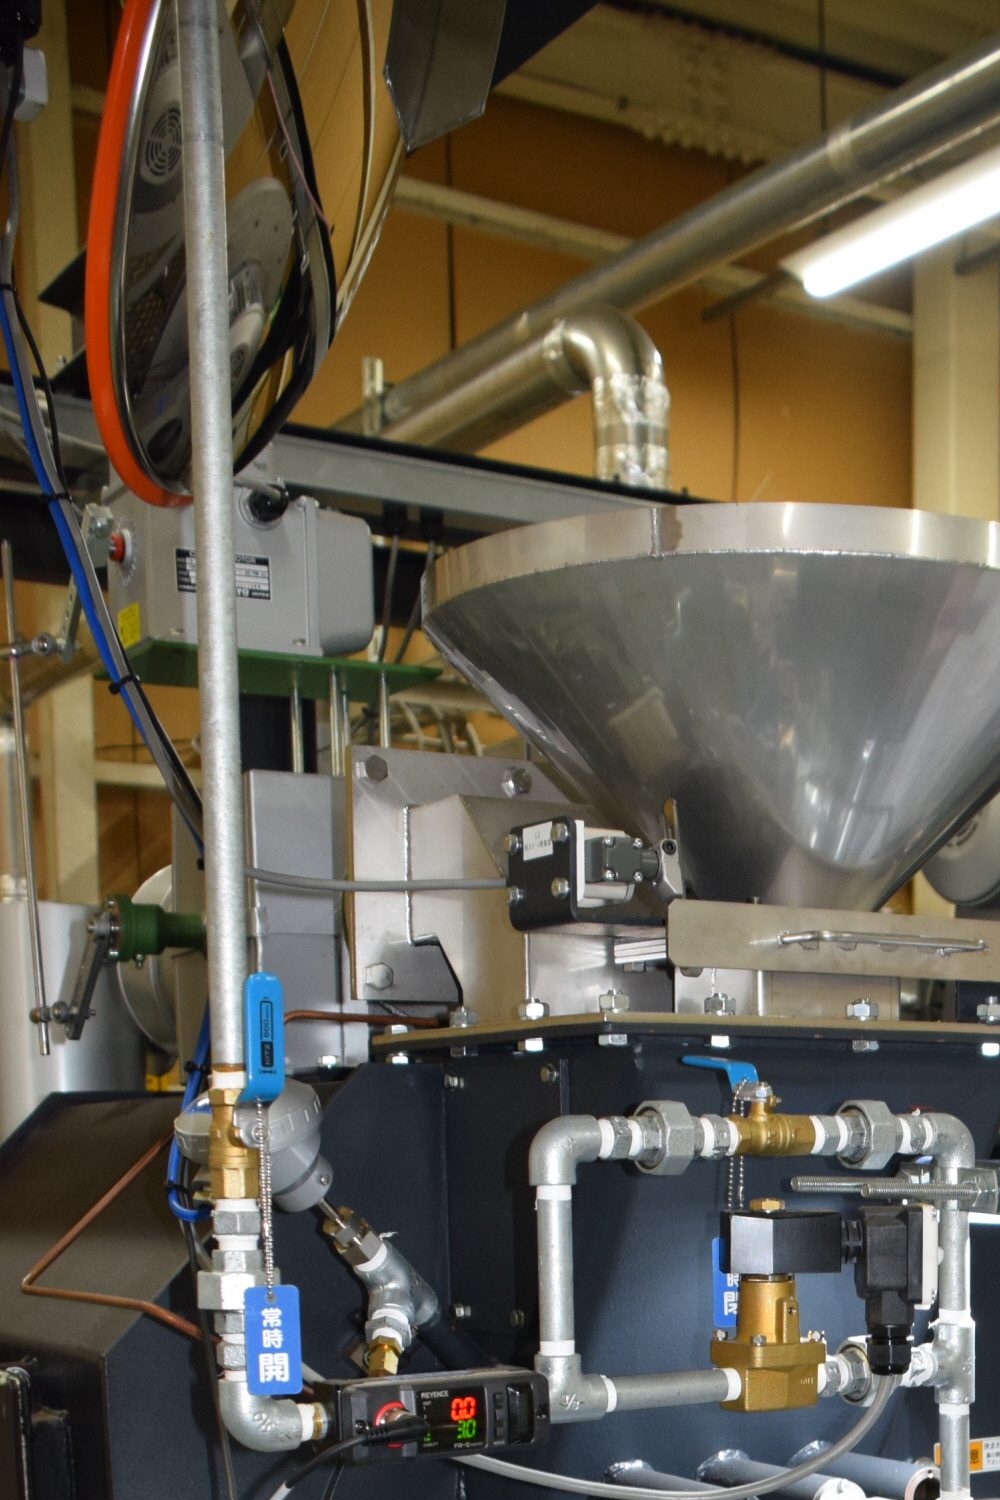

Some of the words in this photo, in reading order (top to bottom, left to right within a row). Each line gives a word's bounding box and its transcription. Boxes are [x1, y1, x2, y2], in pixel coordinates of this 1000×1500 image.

[258, 1307, 290, 1384] 常時開
[420, 1390, 449, 1400] KEYENCE
